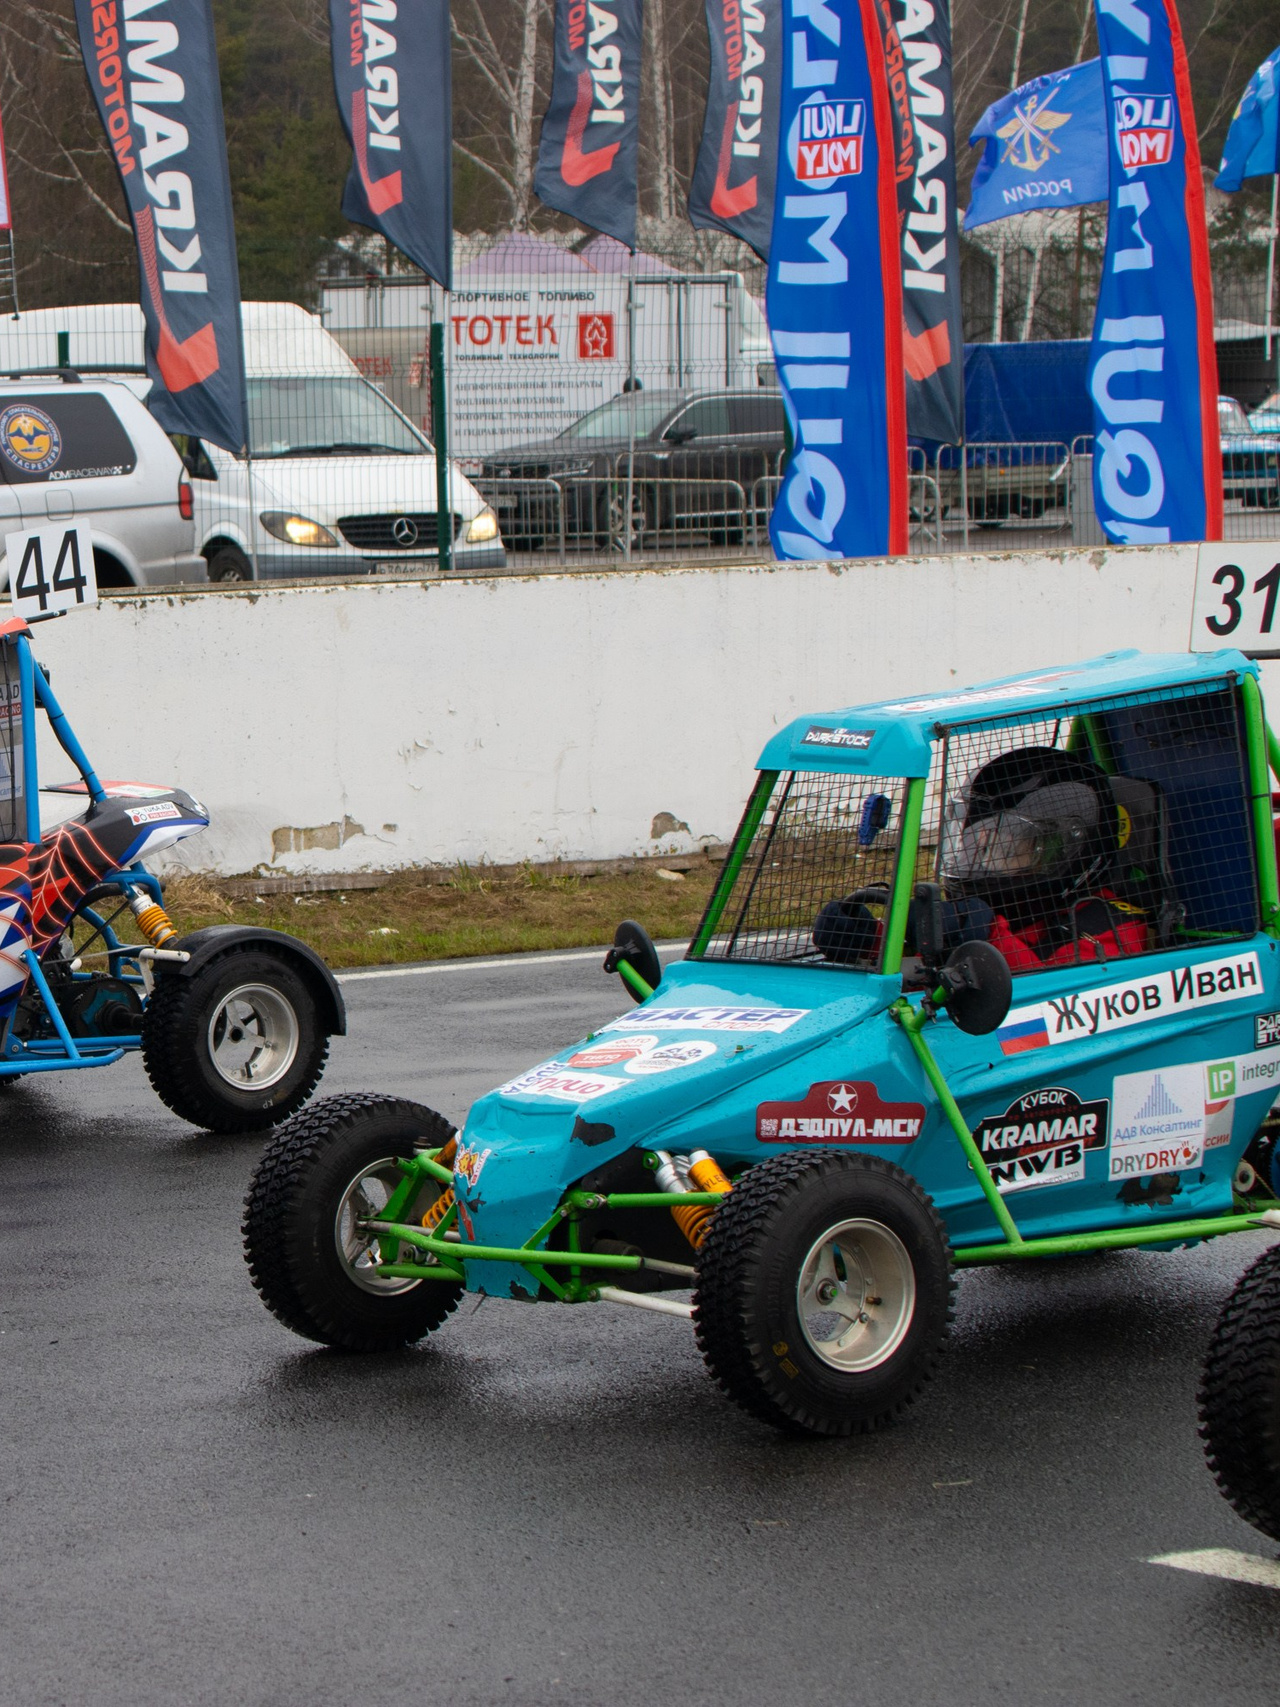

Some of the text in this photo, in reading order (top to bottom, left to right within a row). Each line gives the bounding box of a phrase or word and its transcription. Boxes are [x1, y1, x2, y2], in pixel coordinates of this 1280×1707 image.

[538, 290, 596, 301] ТОПЛИВО
[451, 313, 558, 346] ТОТЕК
[349, 357, 393, 376] ОТЕК
[16, 528, 87, 611] 44
[1205, 563, 1280, 636] 31
[1048, 960, 1257, 1035] Жуков Иван
[1211, 1060, 1280, 1093] IP integr
[1020, 1090, 1068, 1112] КУБОК
[982, 1113, 1097, 1151] KRAMAR
[1114, 1117, 1203, 1141] АДВ Консалтинг
[990, 1143, 1082, 1187] NWB
[1111, 1149, 1181, 1176] DRYDRY
